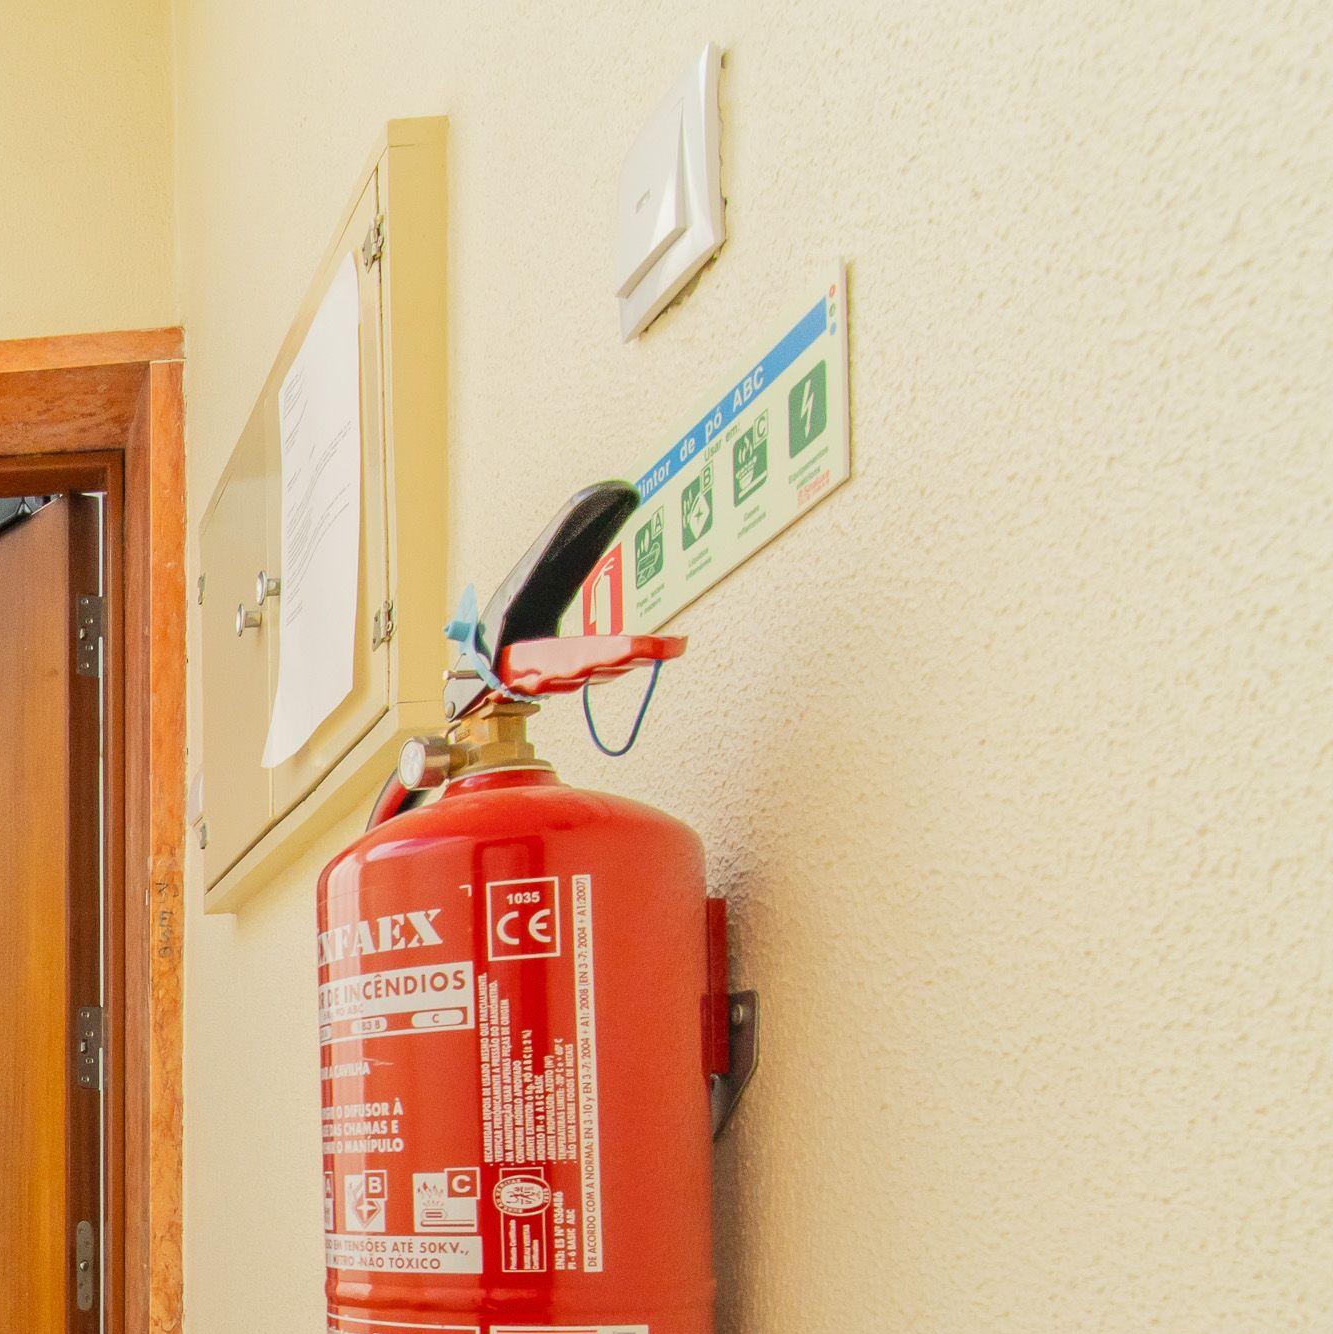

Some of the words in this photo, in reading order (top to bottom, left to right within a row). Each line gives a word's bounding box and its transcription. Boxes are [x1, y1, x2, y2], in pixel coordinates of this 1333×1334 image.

[679, 437, 696, 462] de
[704, 407, 722, 443] pó
[732, 366, 764, 413] ABC
[757, 416, 766, 438] C
[704, 438, 722, 462] Usar
[703, 466, 711, 488] B
[655, 512, 662, 533] A
[506, 890, 541, 905] 1035
[496, 908, 551, 946] CE
[578, 927, 587, 948] 2004
[344, 969, 466, 1003] INCÊNDIOS
[580, 988, 589, 1010] 2008
[432, 1013, 439, 1023] C
[581, 1037, 590, 1058] 2004
[583, 1082, 591, 1093] EN
[343, 1102, 390, 1118] DIFUSOR
[343, 1120, 388, 1136] CHAMAS
[391, 1119, 399, 1134] E
[585, 1128, 593, 1139] EN
[344, 1136, 404, 1153] MANÍPULO
[585, 1142, 594, 1179] NORMA:
[368, 1176, 382, 1194] B
[451, 1175, 471, 1193] C
[586, 1192, 595, 1212] COM
[567, 1209, 575, 1224] ABC
[587, 1216, 596, 1253] ACORDO
[344, 1238, 386, 1253] TENSÕES
[391, 1238, 413, 1254] ATÉ
[389, 1255, 441, 1269] TÓXICO
[588, 1256, 597, 1267] DE
